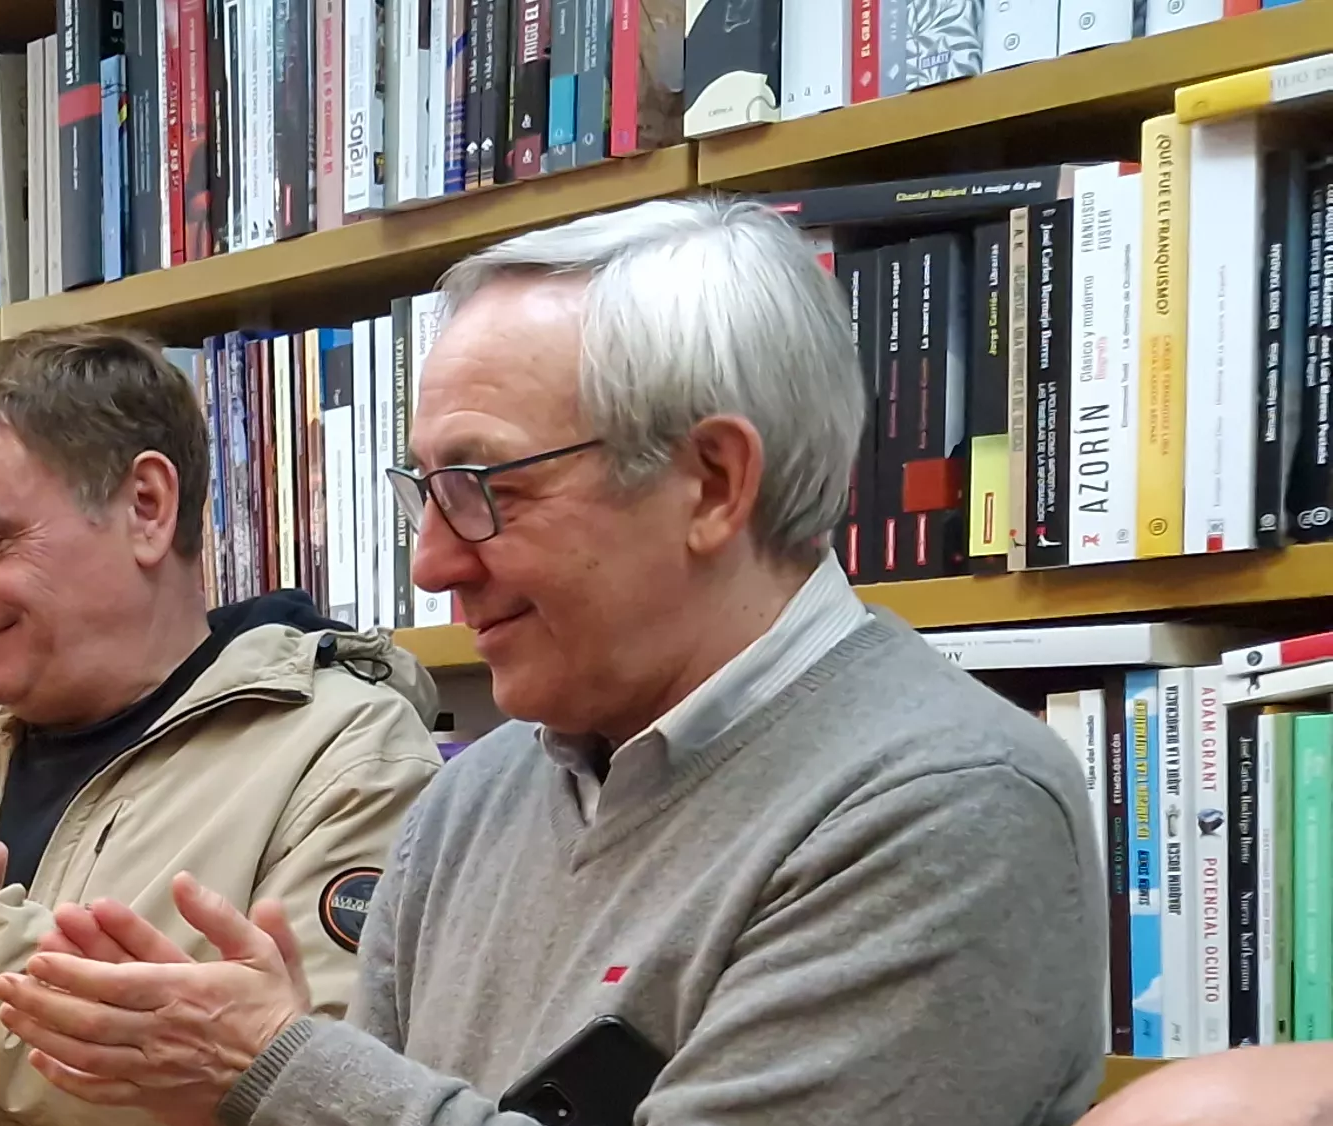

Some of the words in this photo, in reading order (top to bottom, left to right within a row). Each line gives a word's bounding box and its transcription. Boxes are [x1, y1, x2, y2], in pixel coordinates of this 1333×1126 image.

[345, 111, 368, 178] riglos
[1156, 134, 1174, 169] ¿QUÉ
[1158, 171, 1171, 197] FUE
[1081, 192, 1095, 253] FRANCISCO
[1158, 200, 1171, 216] EL
[1040, 223, 1055, 247] José
[1097, 210, 1112, 250] FUSTER
[889, 262, 901, 297] vegetal
[1041, 248, 1054, 284] Carlos
[1154, 219, 1171, 316] FRANQUISMO?
[889, 297, 900, 309] es
[889, 311, 899, 340] futuro
[889, 342, 899, 352] El
[1048, 381, 1057, 393] LA
[1074, 404, 1110, 513] AZORÍN
[1165, 685, 1180, 744] DEMOCRACIA
[1202, 687, 1218, 732] ADAM
[1086, 748, 1095, 764] del
[1166, 747, 1180, 757] LA
[1202, 738, 1217, 792] GRANT
[1240, 736, 1255, 759] José
[1110, 733, 1122, 804] ETIMOLOGICÓN
[1166, 768, 1182, 796] JAQUE
[1240, 761, 1254, 792] Carlos
[1239, 795, 1254, 835] Rodrigo
[1167, 842, 1181, 872] BOSCH
[1168, 875, 1183, 915] JOAQUIM
[1203, 858, 1218, 939] POTENCIAL
[1205, 946, 1220, 1003] OCULTO
